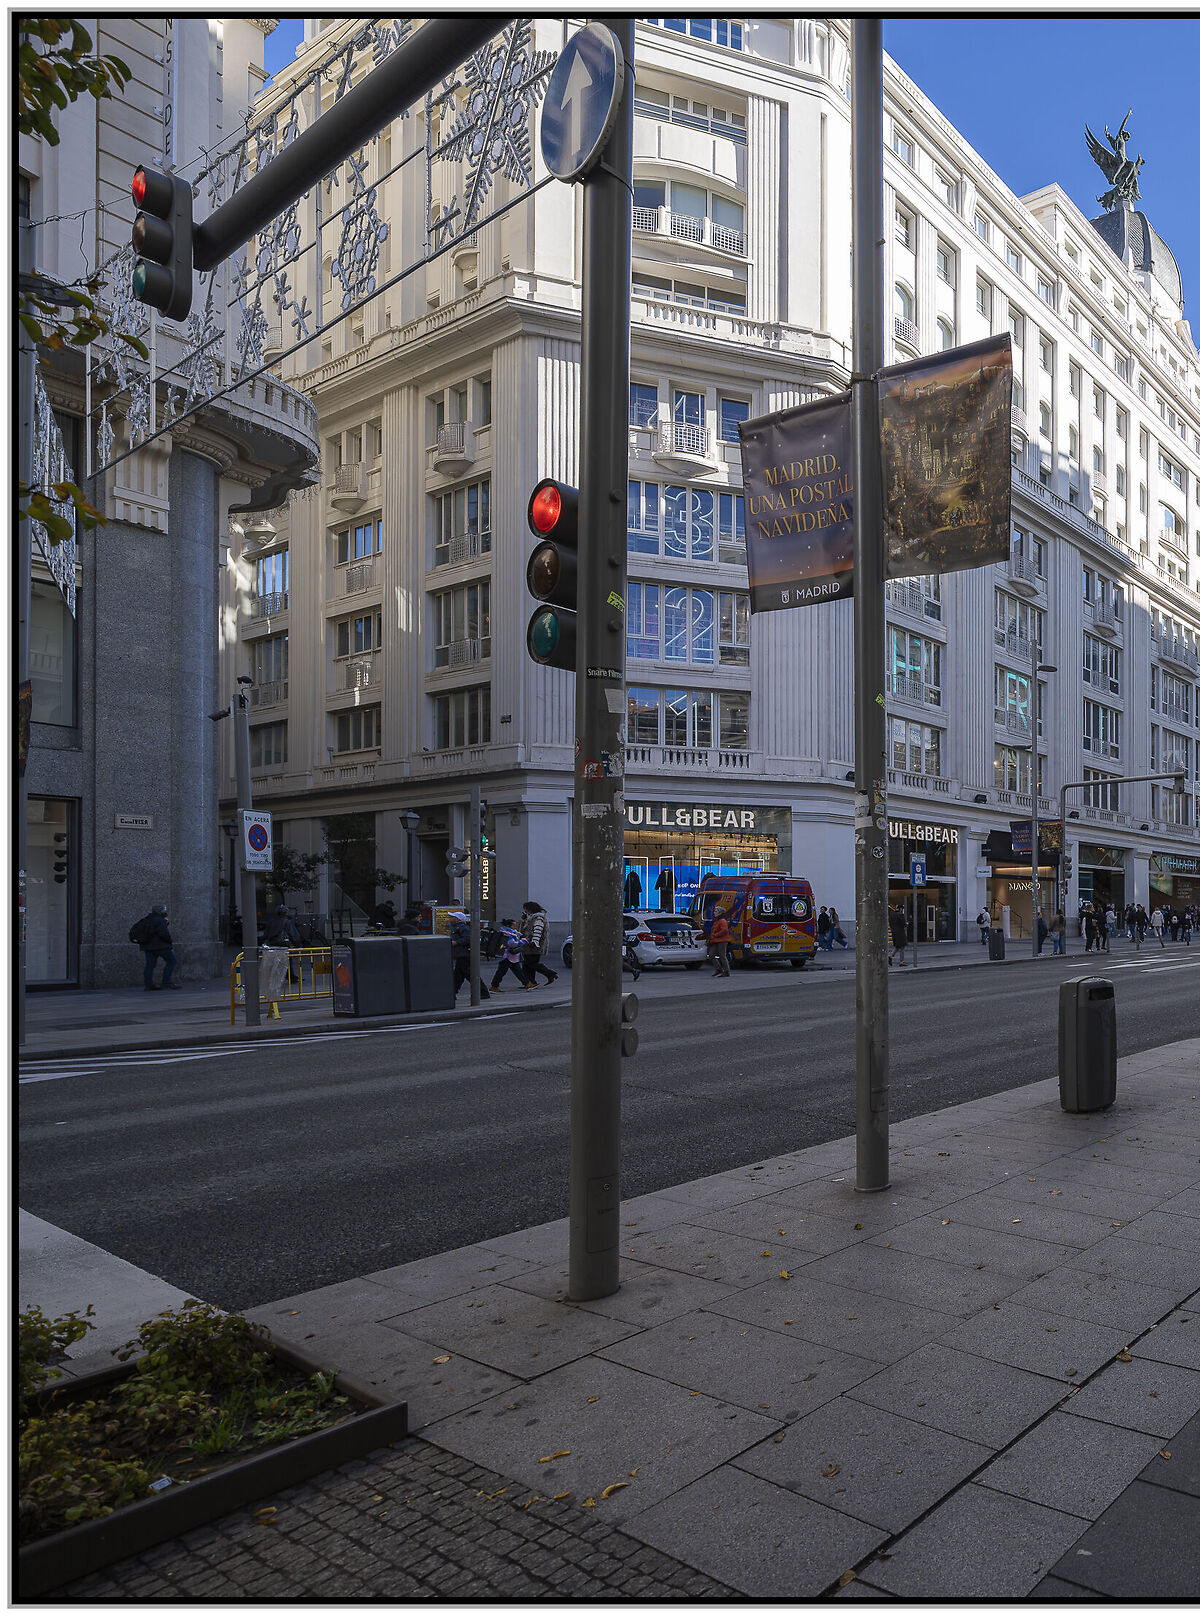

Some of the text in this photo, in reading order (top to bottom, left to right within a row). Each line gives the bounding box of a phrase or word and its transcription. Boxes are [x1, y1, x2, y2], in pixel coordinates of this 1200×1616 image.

[763, 454, 841, 488] MADRID,
[750, 473, 854, 515] UNA POSTAL
[758, 503, 849, 540] NAVIDEÑA
[796, 582, 840, 599] MADRID
[587, 668, 607, 677] Snare
[623, 806, 755, 828] ULL&BEAR
[888, 821, 958, 843] ULL&BEAR
[1161, 856, 1197, 872] PRIMARK
